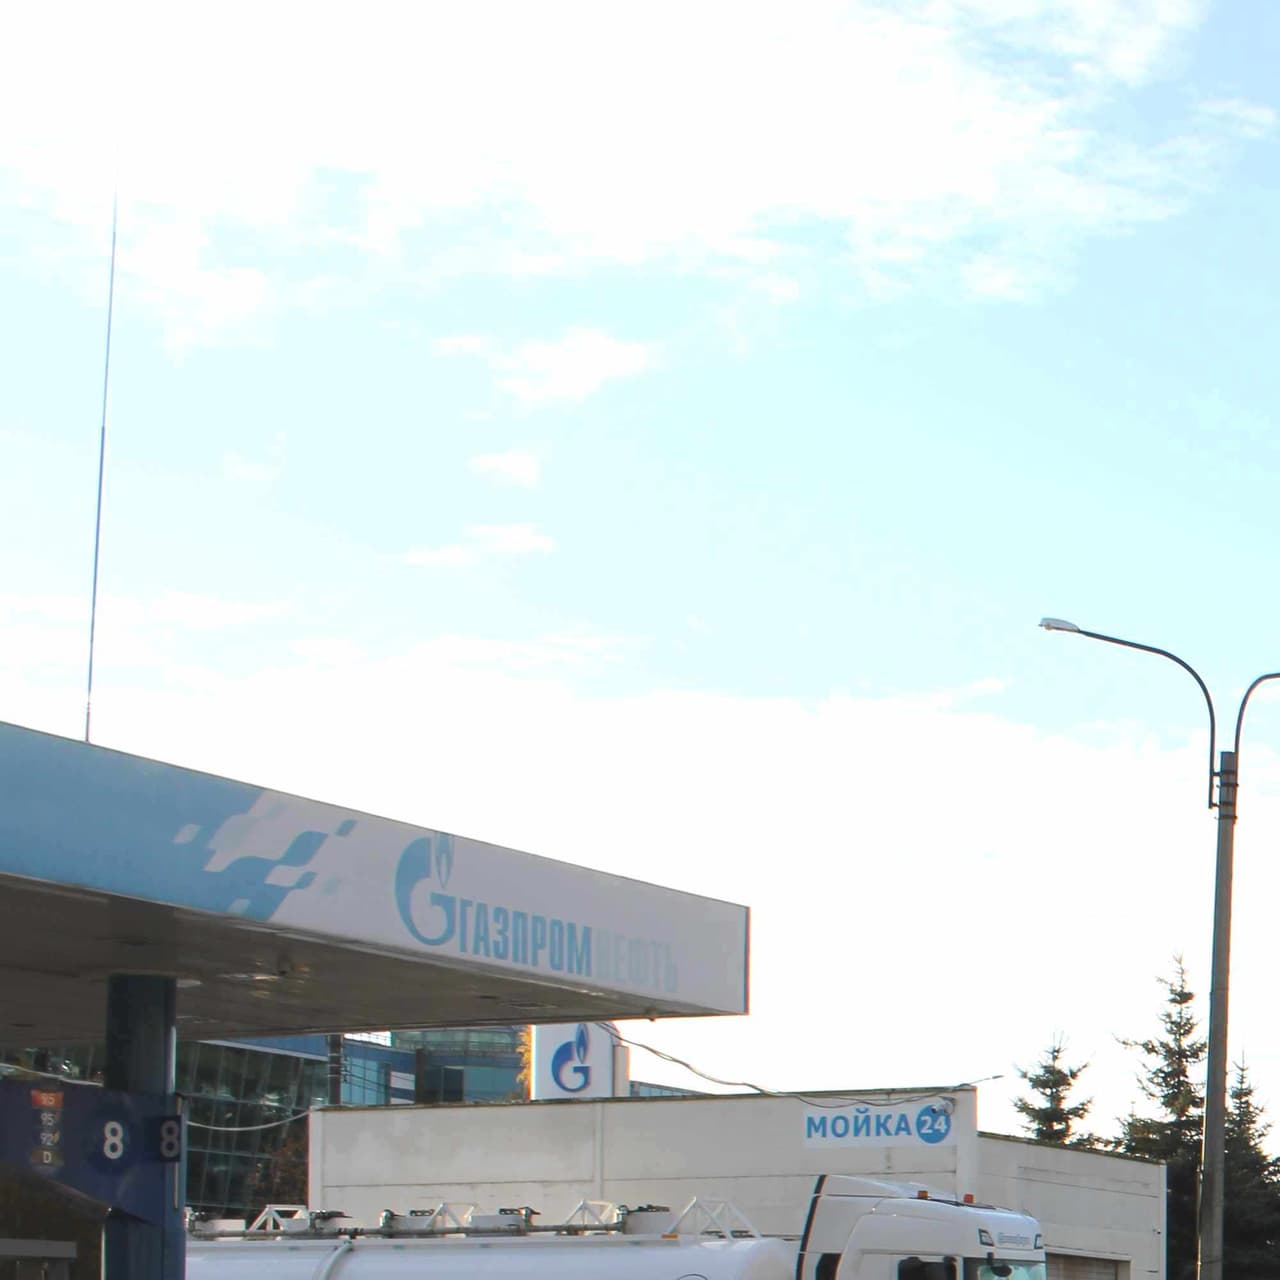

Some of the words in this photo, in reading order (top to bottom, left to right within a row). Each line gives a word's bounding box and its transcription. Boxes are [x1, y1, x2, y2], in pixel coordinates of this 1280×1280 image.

[458, 898, 592, 977] ГАЗПРОМ
[103, 1121, 124, 1160] 8
[160, 1119, 180, 1158] 8
[806, 1107, 912, 1138] МОЙКА
[919, 1115, 948, 1134] 24
[43, 1151, 52, 1164] D
